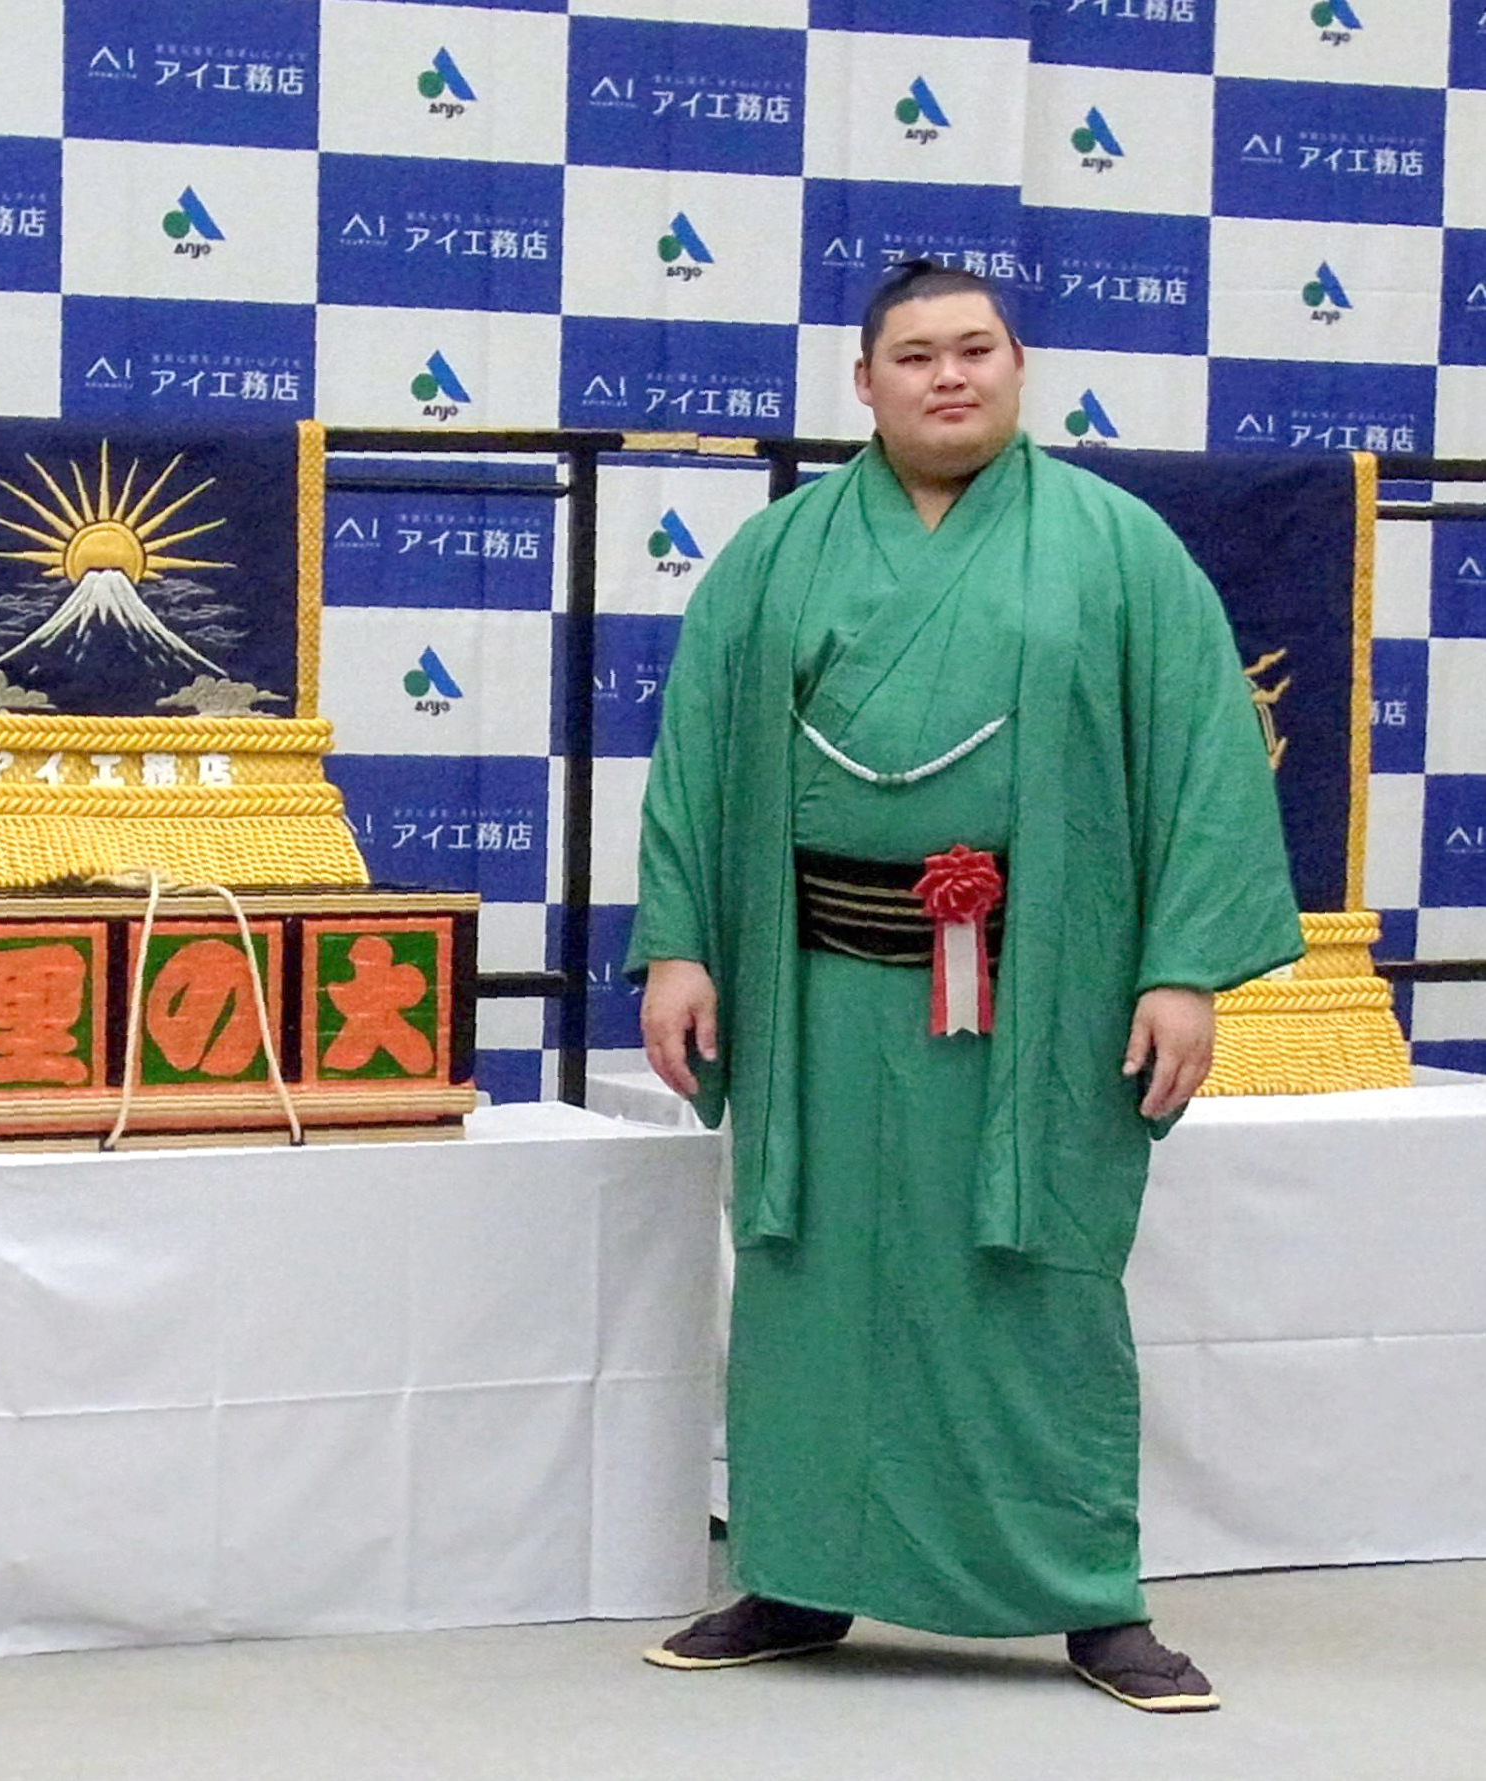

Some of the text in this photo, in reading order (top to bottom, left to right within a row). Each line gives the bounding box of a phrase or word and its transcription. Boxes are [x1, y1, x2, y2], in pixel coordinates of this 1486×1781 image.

[156, 61, 303, 94] アイ工務店
[653, 91, 790, 123] アイ工務店
[1300, 147, 1422, 176] アイ工務店
[406, 228, 547, 259] アイ工務店
[1061, 275, 1187, 304] アイ工務店
[151, 370, 298, 400] アイ工務店
[646, 388, 781, 417] アイ工務店
[1291, 426, 1413, 452] アイ工務店
[398, 530, 539, 559] アイ工務店
[393, 821, 532, 850] アイ工務店
